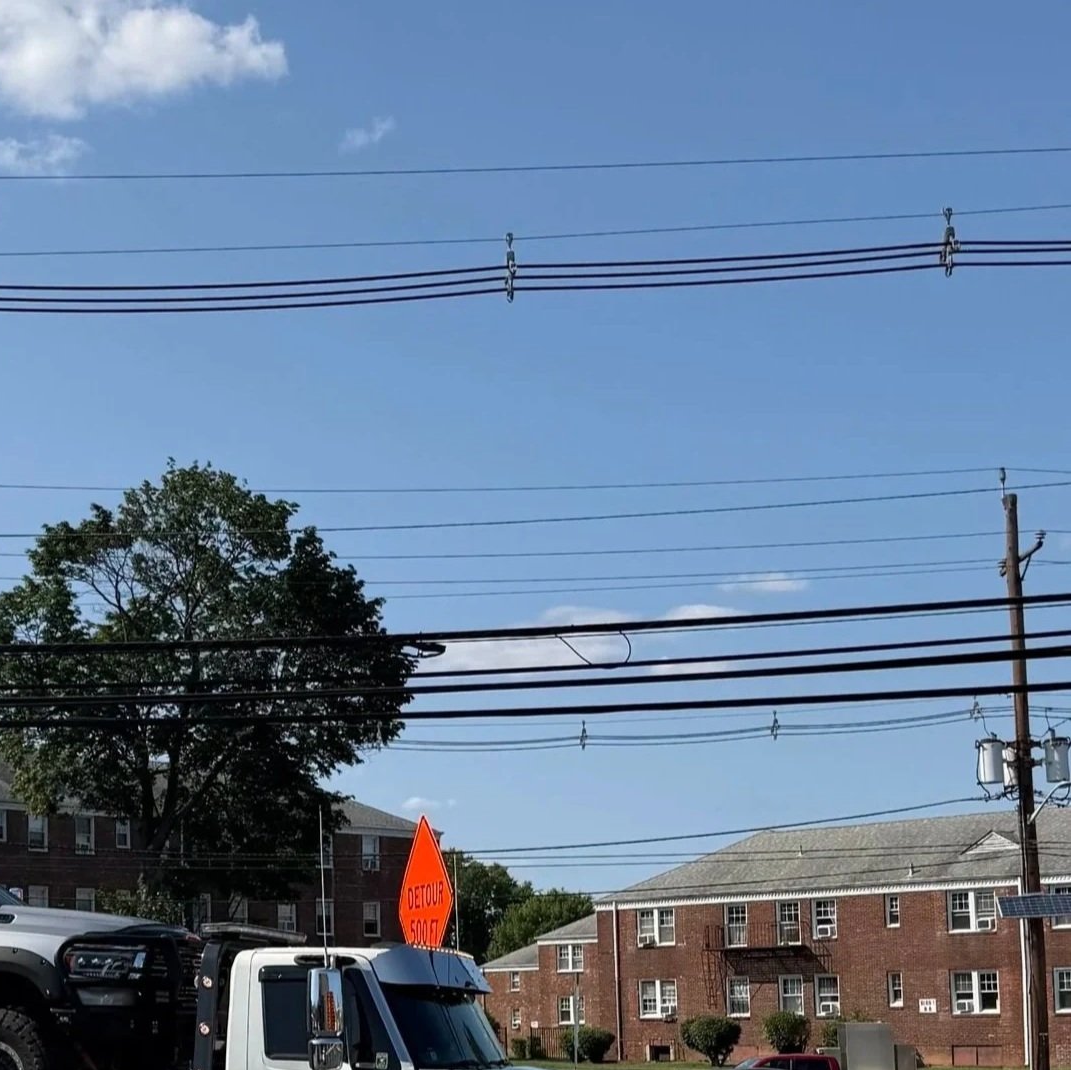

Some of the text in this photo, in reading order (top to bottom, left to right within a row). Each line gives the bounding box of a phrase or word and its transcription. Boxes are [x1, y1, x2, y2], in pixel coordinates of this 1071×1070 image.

[408, 880, 443, 910] DETOUR
[410, 919, 439, 944] 500 FT
